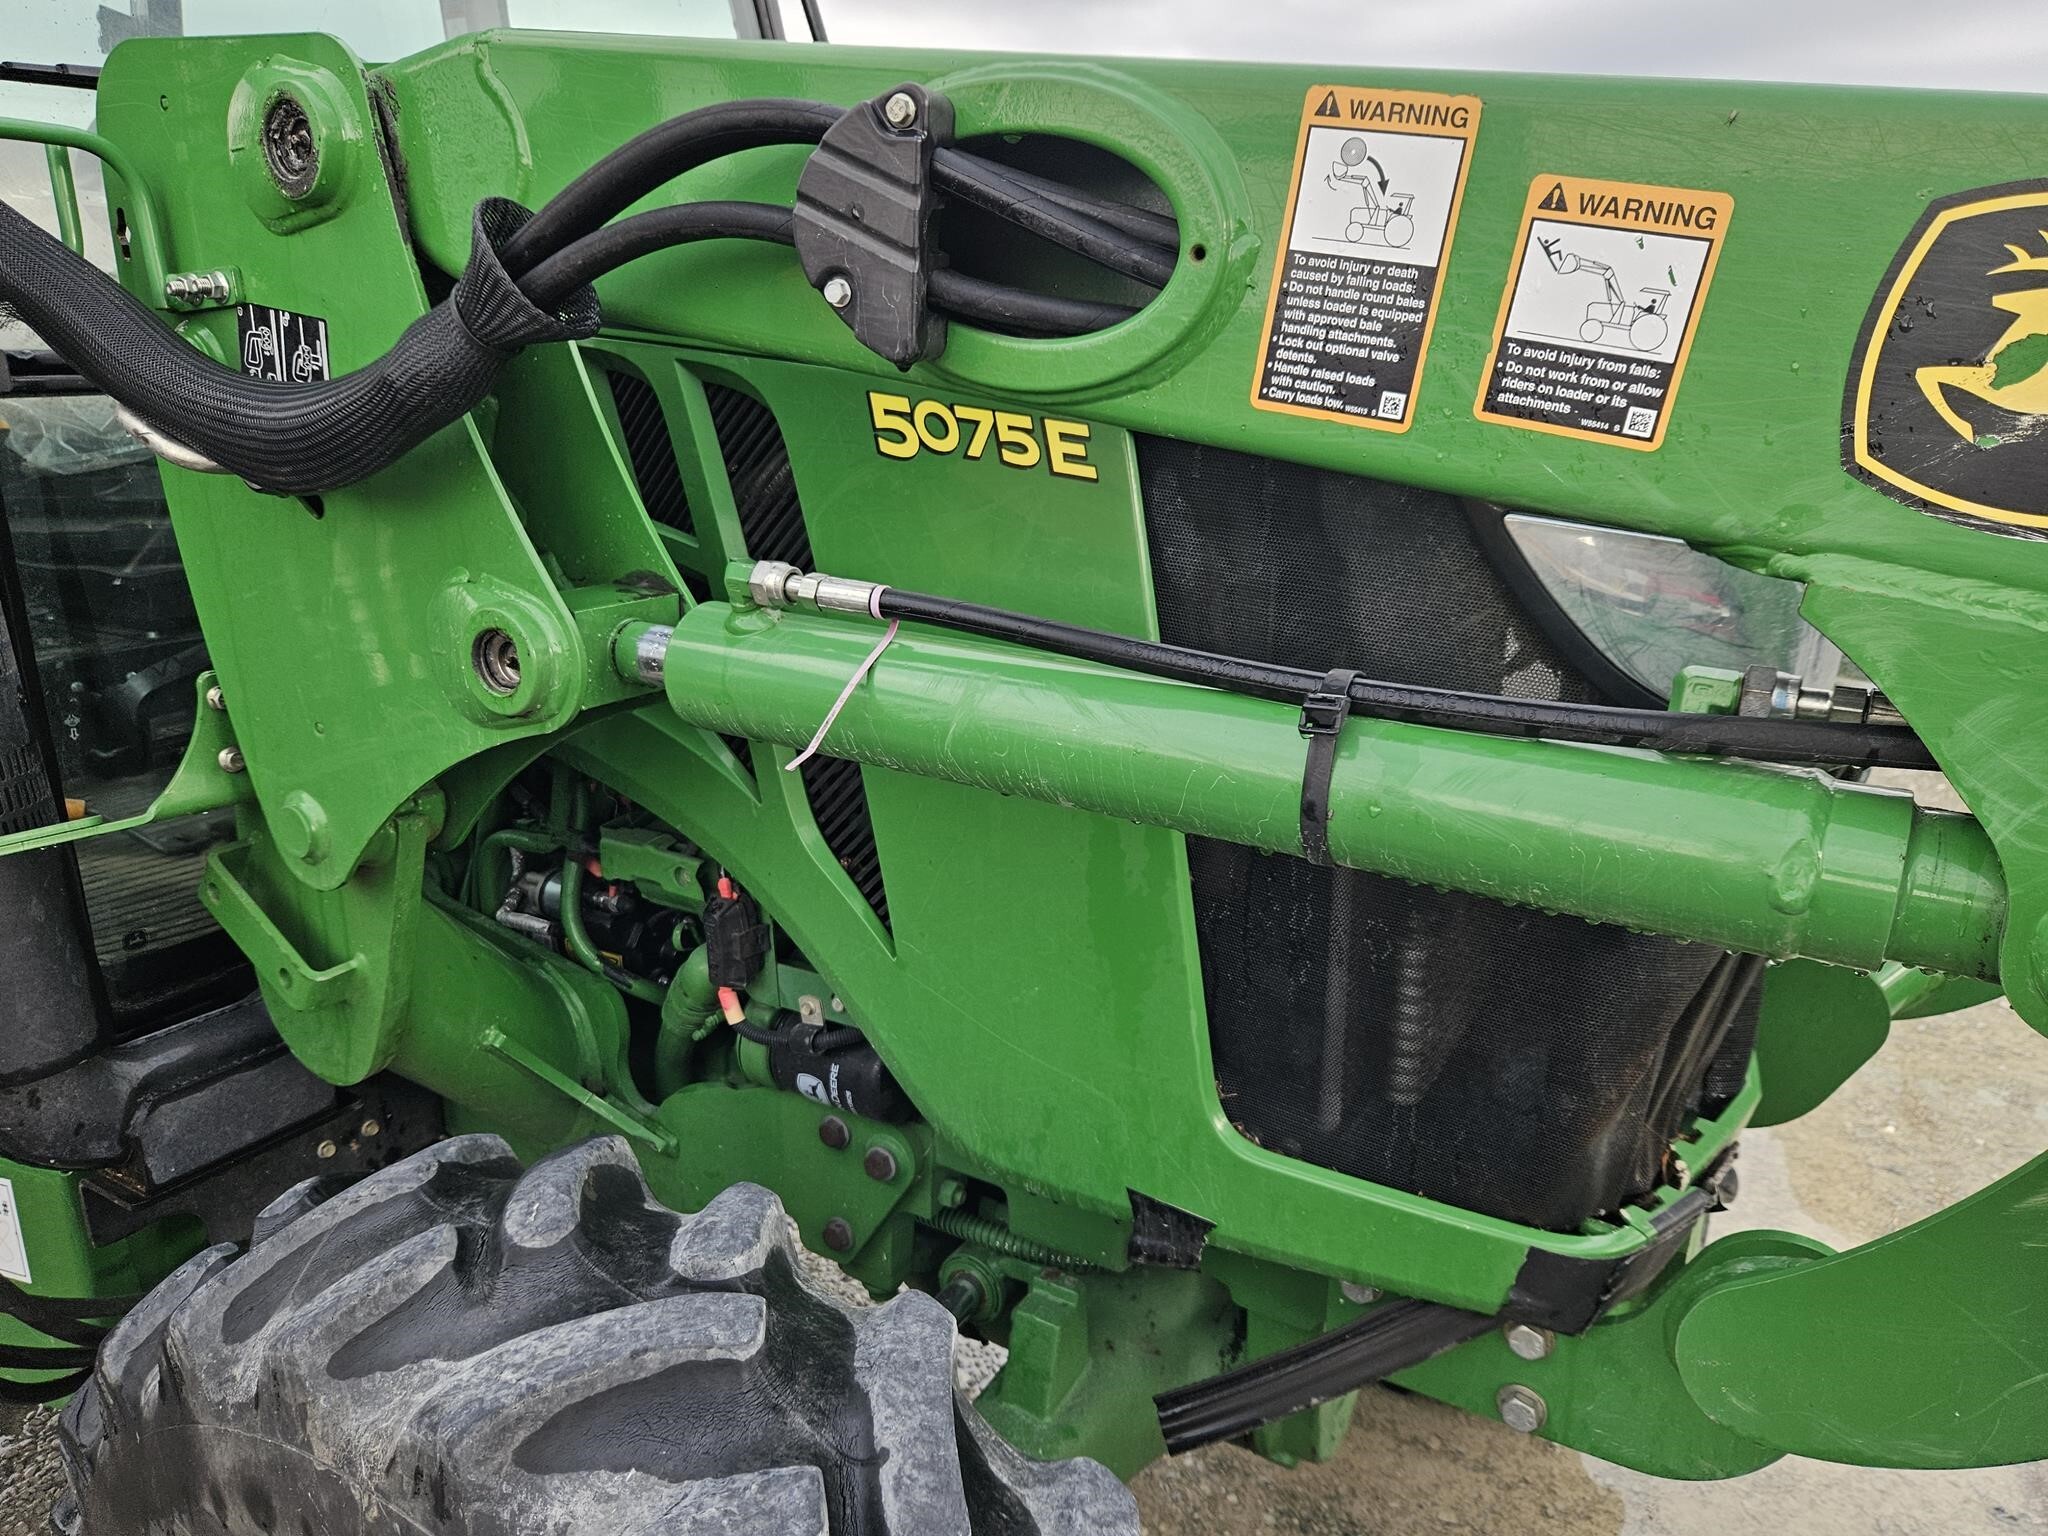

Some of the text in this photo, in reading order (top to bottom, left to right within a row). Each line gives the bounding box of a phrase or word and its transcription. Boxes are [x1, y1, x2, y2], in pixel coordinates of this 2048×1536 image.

[1350, 99, 1469, 128] WARNING
[1580, 192, 1717, 230] WARNING
[1294, 254, 1418, 279] To avoid injury or death
[1291, 269, 1416, 293] caused by falling loads:
[1290, 281, 1425, 309] Do not handle round bales
[1284, 309, 1382, 332] with approved bale
[1287, 296, 1423, 323] unless loader is equipped
[1281, 321, 1397, 348] handling attachments.
[1279, 335, 1399, 362] Lock out optional valve
[1508, 343, 1520, 355] To
[1524, 347, 1555, 361] avoid
[1559, 352, 1595, 370] injury
[1597, 358, 1627, 373] from
[1271, 375, 1292, 387] with
[1274, 360, 1376, 387] Handle raised loads
[1506, 361, 1664, 398] Do not work from or allow
[1269, 387, 1295, 402] Carry
[1296, 391, 1322, 406] loads
[1502, 376, 1628, 408] riders on loader or its
[867, 391, 1098, 482] 5075E
